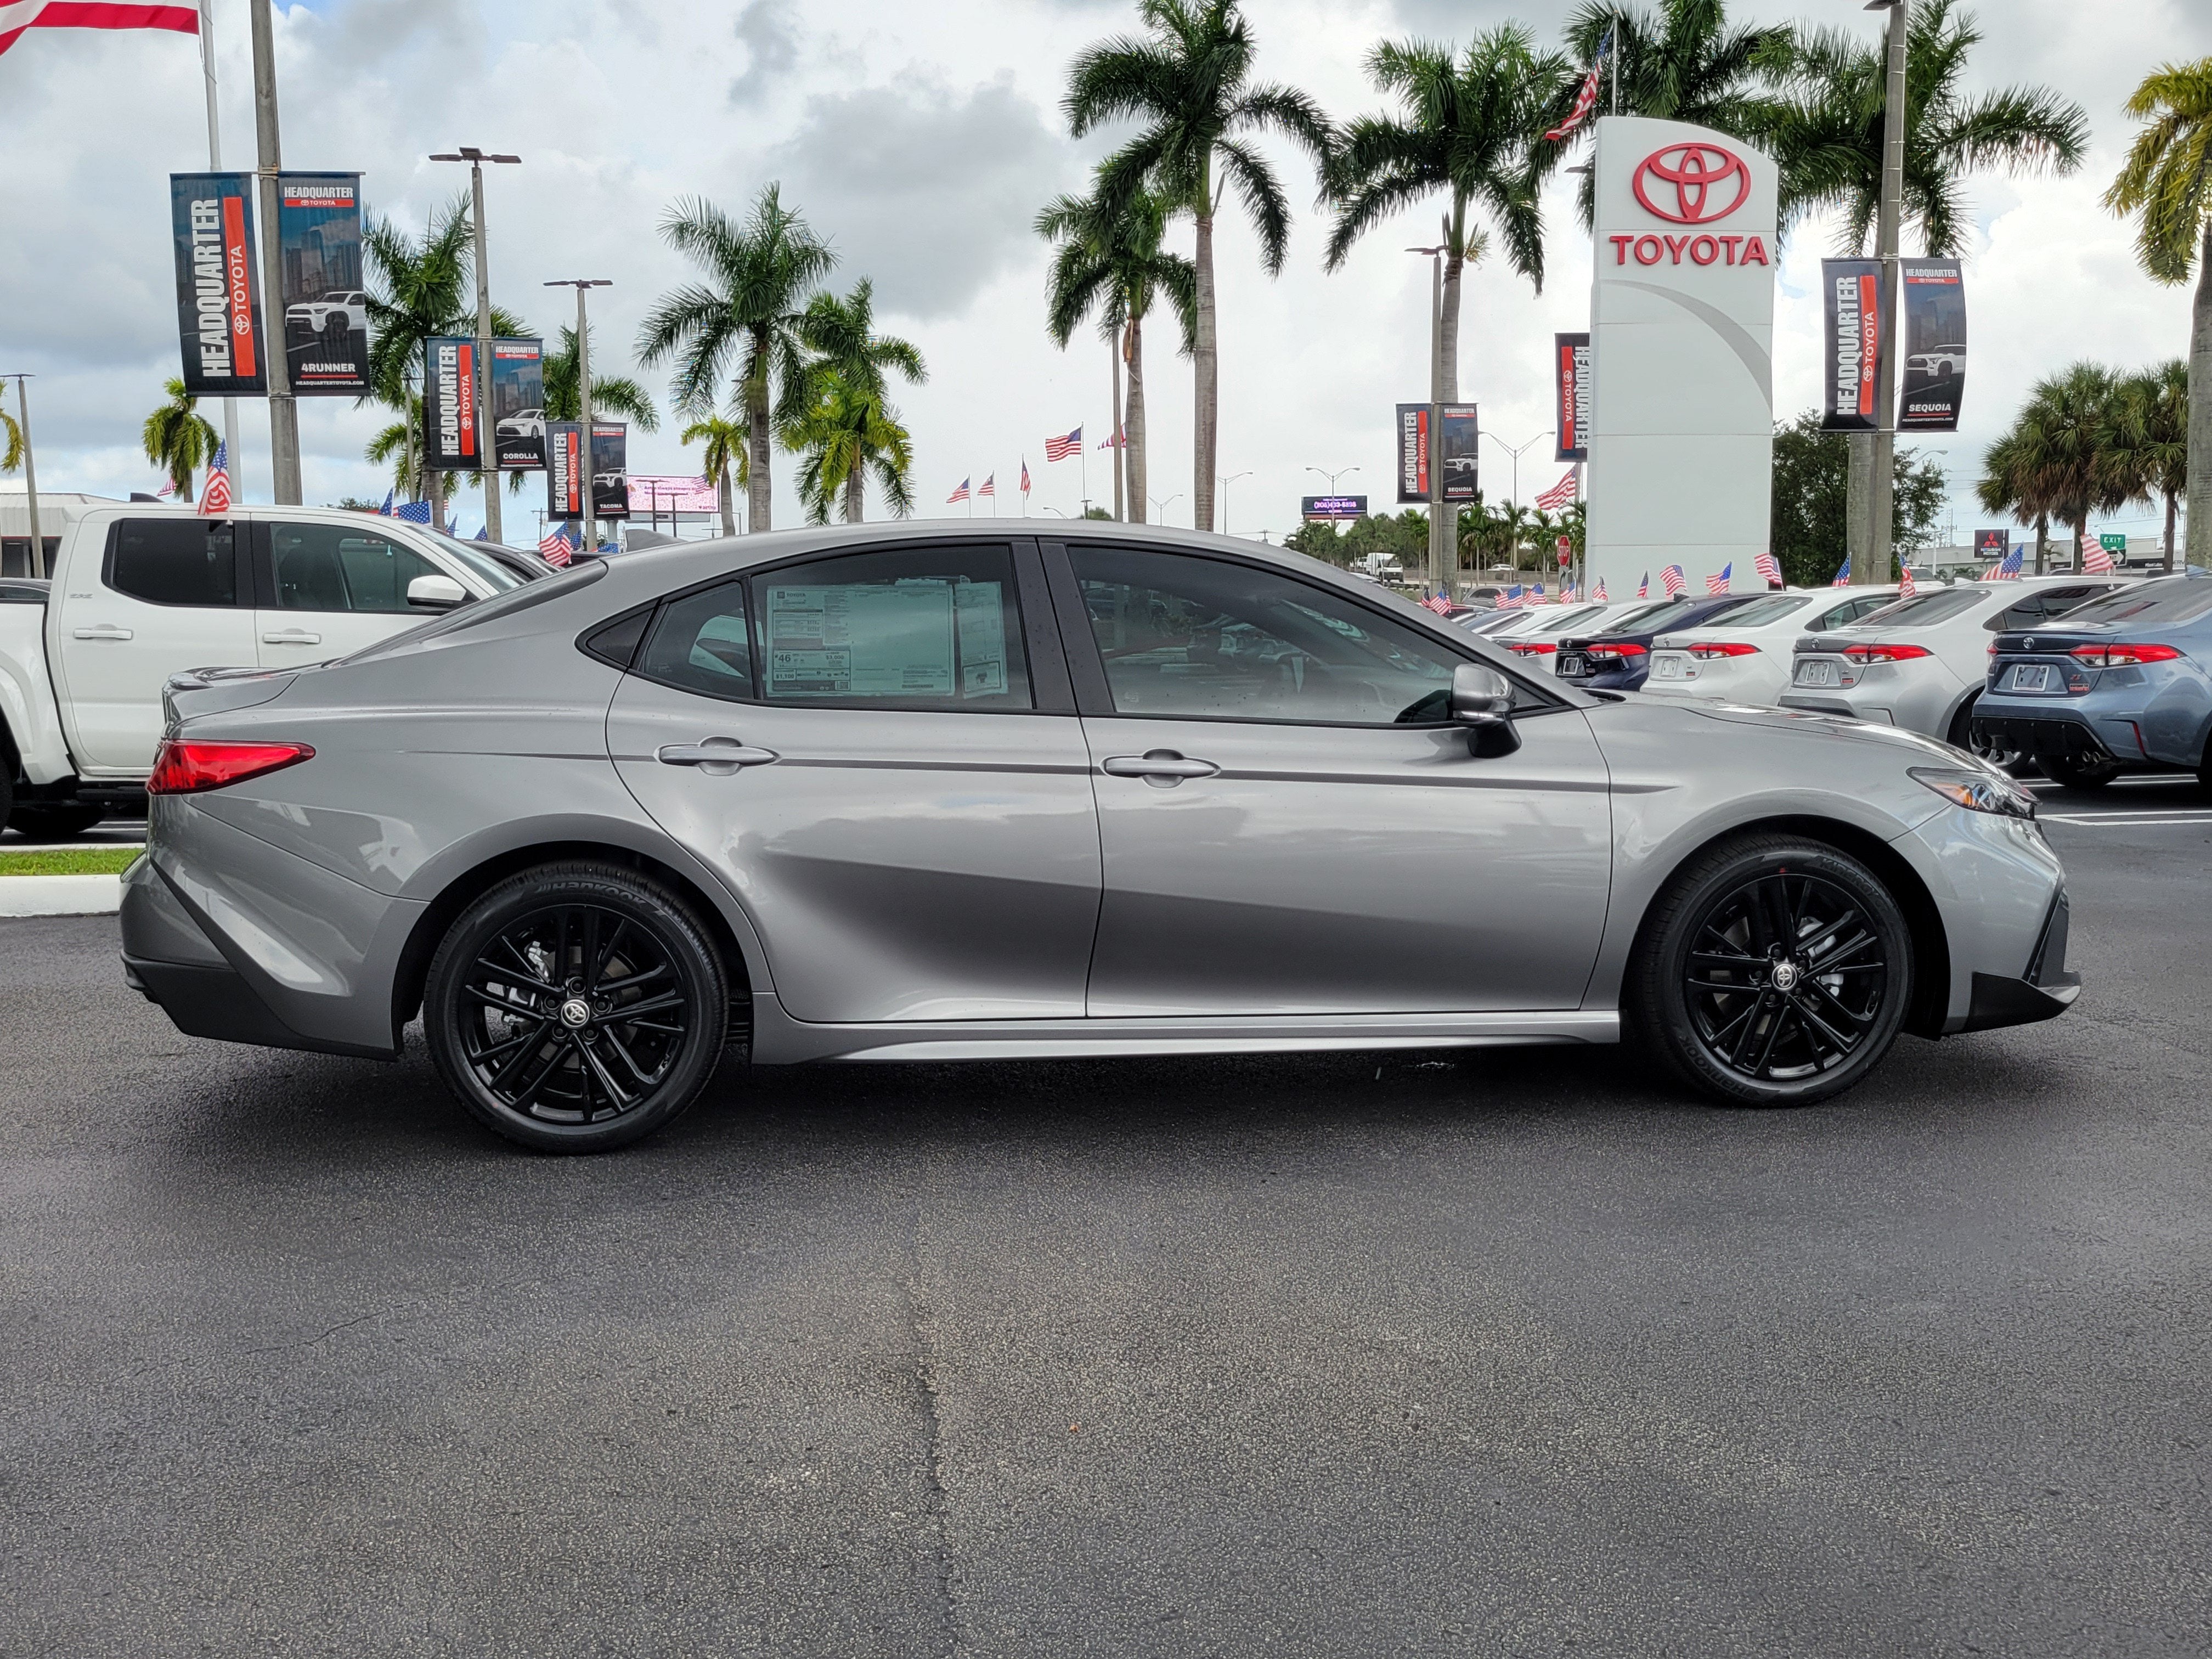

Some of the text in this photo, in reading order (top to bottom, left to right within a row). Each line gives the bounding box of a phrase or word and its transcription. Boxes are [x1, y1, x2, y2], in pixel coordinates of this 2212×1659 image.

[284, 187, 353, 199] HEADQUARTER
[1609, 234, 1769, 266] TOYOTA
[191, 199, 232, 377] HEADQUARTER
[230, 245, 246, 312] TOYOTA
[1906, 268, 1957, 277] HEADQUARTER
[495, 346, 539, 354] HEADQUARTER
[1836, 276, 1863, 415] HEADQUARTER
[1865, 312, 1875, 363] TOYOTA
[301, 363, 356, 372] 4RUNNER
[439, 346, 460, 455] HEADQUARTER
[461, 375, 470, 415] TOYOTA
[1573, 346, 1589, 449] HEADQUARTER
[1909, 403, 1951, 413] SEQUOIA
[555, 433, 568, 512] HEADQUARTER
[1404, 412, 1418, 494] HEADQUARTER
[1558, 545, 1570, 557] STOP
[778, 654, 791, 662] 46
